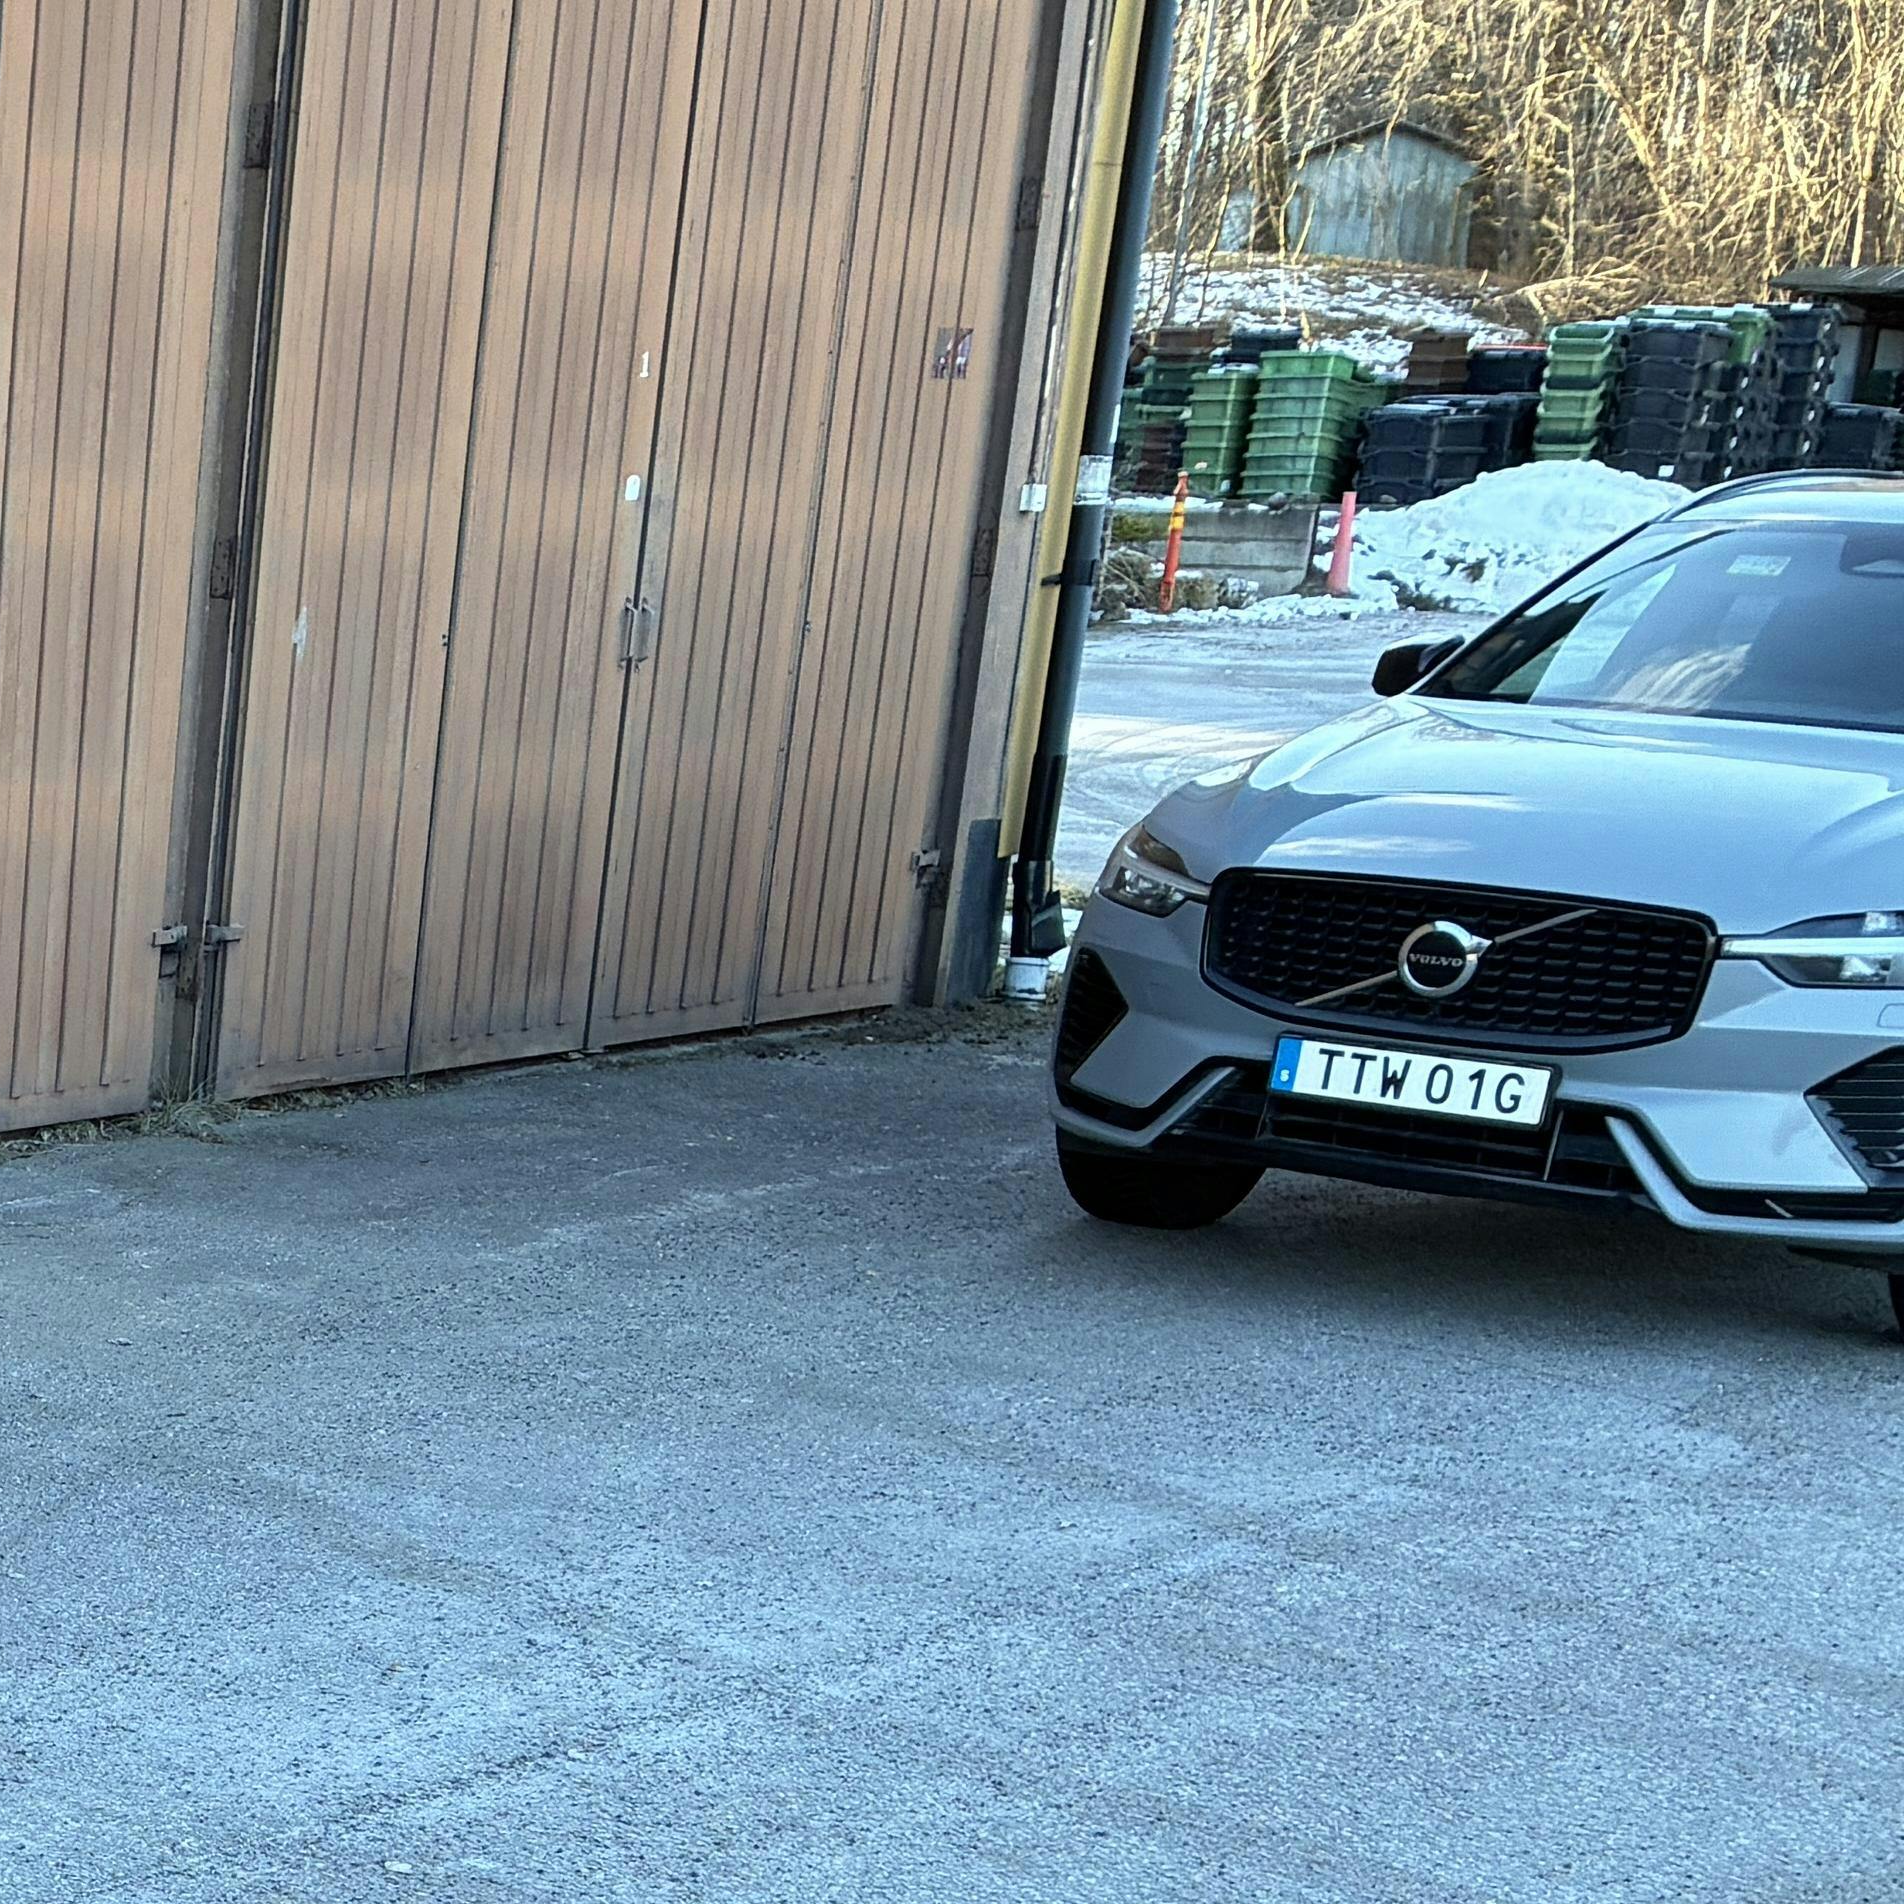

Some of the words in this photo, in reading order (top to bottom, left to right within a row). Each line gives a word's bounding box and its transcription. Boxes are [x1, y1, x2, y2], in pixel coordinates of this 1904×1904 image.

[1408, 953, 1463, 968] VOLVO
[1279, 1068, 1290, 1083] S
[1318, 1048, 1413, 1100] TTW
[1424, 1063, 1526, 1114] 01G
